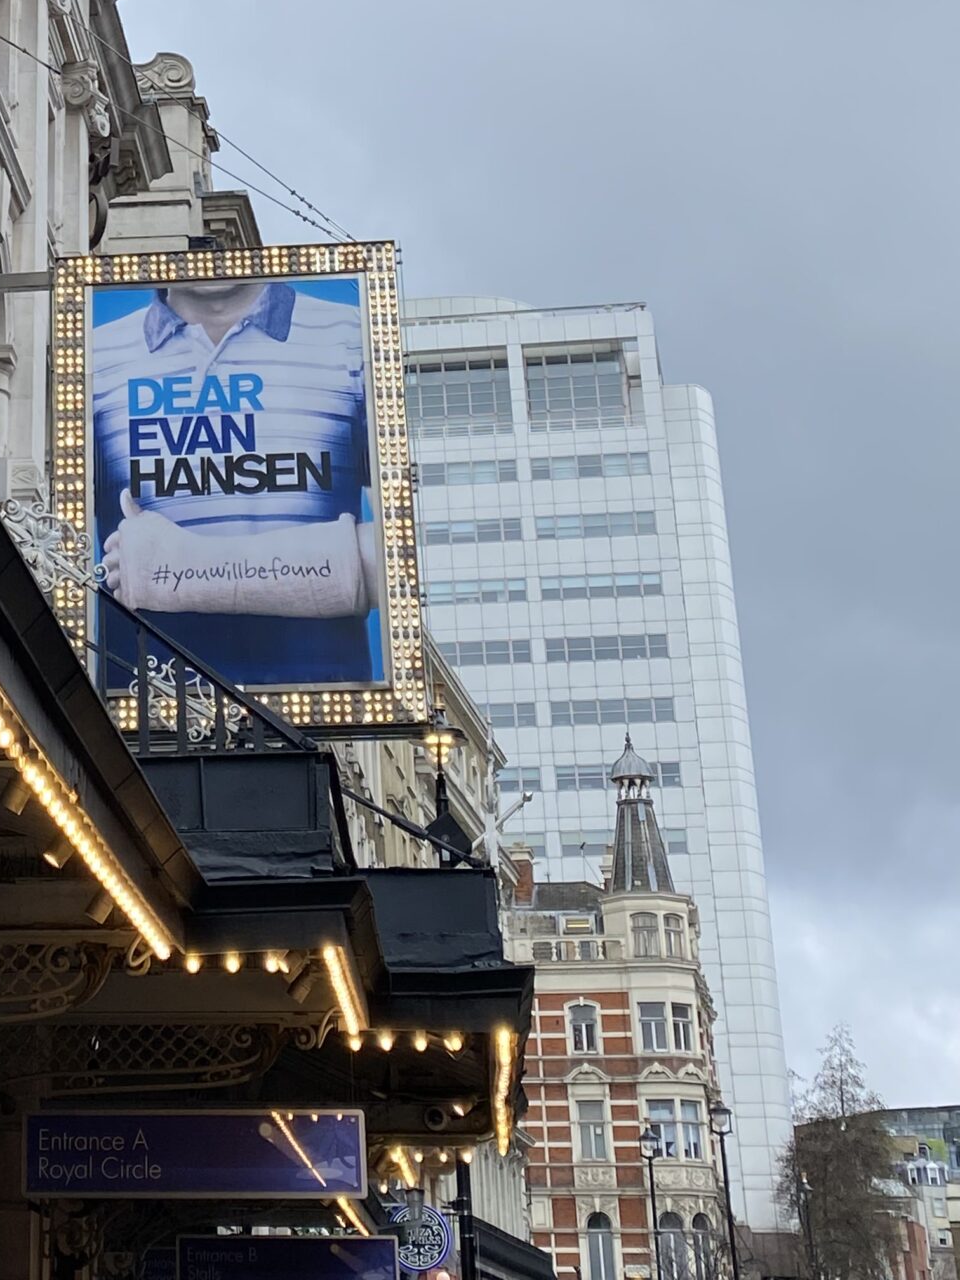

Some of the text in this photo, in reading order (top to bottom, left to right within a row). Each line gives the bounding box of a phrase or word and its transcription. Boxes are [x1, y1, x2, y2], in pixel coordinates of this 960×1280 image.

[128, 373, 265, 416] DEAR
[129, 413, 256, 457] EVAN
[130, 451, 333, 498] HANSEN
[152, 557, 331, 592] #youwillbefound
[39, 1128, 149, 1151] Entrance A
[39, 1154, 162, 1187] Royal Circle
[187, 1246, 244, 1263] Entrance
[248, 1246, 258, 1262] B
[187, 1264, 221, 1280] Stalls
